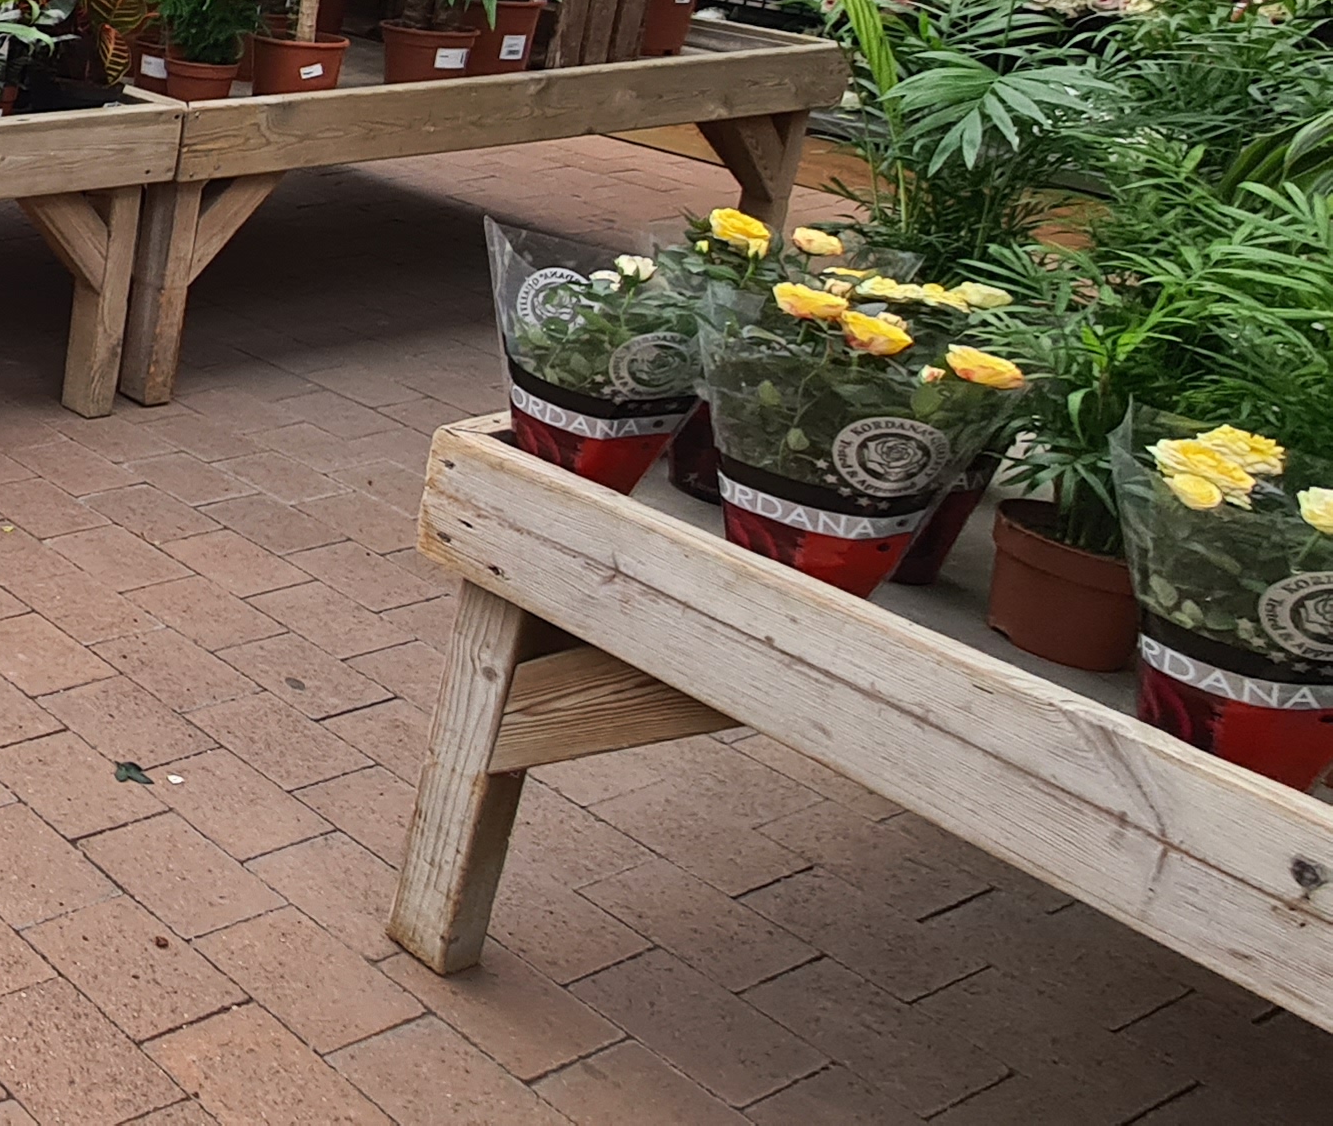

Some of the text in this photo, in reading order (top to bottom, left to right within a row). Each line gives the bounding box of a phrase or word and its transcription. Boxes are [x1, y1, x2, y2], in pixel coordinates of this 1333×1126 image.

[511, 386, 639, 437] ORDANA
[717, 471, 876, 538] ORDANA
[1140, 634, 1321, 710] RDANA
